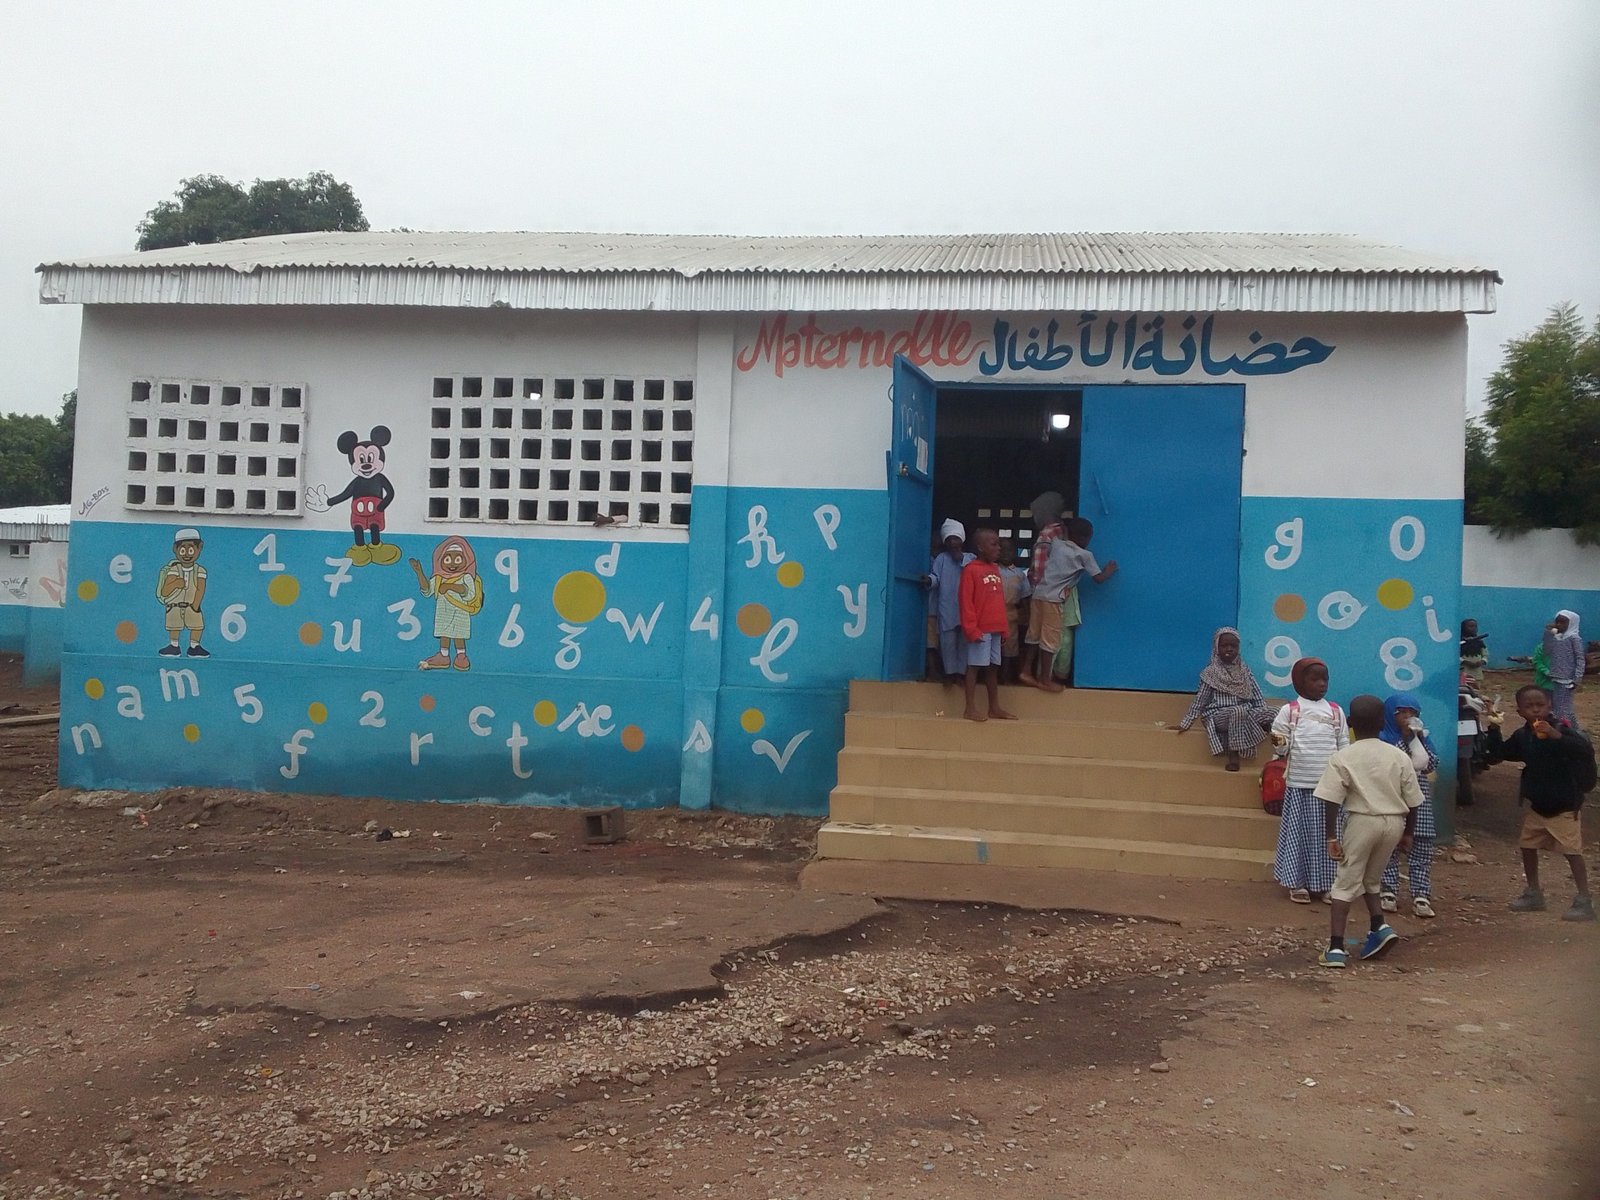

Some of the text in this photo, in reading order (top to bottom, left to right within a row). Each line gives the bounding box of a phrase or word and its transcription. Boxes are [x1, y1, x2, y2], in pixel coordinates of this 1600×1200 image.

[736, 310, 990, 379] Maternelle
[978, 310, 1337, 377] حضانة الأطفال
[109, 554, 133, 584] e
[253, 533, 286, 572] 1
[594, 542, 622, 577] d
[324, 556, 353, 598] 7
[387, 598, 421, 640] 3
[689, 597, 720, 641] 4
[836, 582, 868, 639] y
[1422, 595, 1453, 643] i
[330, 618, 362, 653] u
[1264, 635, 1303, 687] 9
[1379, 636, 1424, 691] 8
[116, 685, 145, 720] a
[159, 668, 200, 701] m
[233, 683, 263, 724] 5
[359, 690, 387, 728] 2
[71, 723, 102, 755] n
[279, 729, 315, 779] f
[410, 732, 434, 766] r
[506, 721, 534, 779] t
